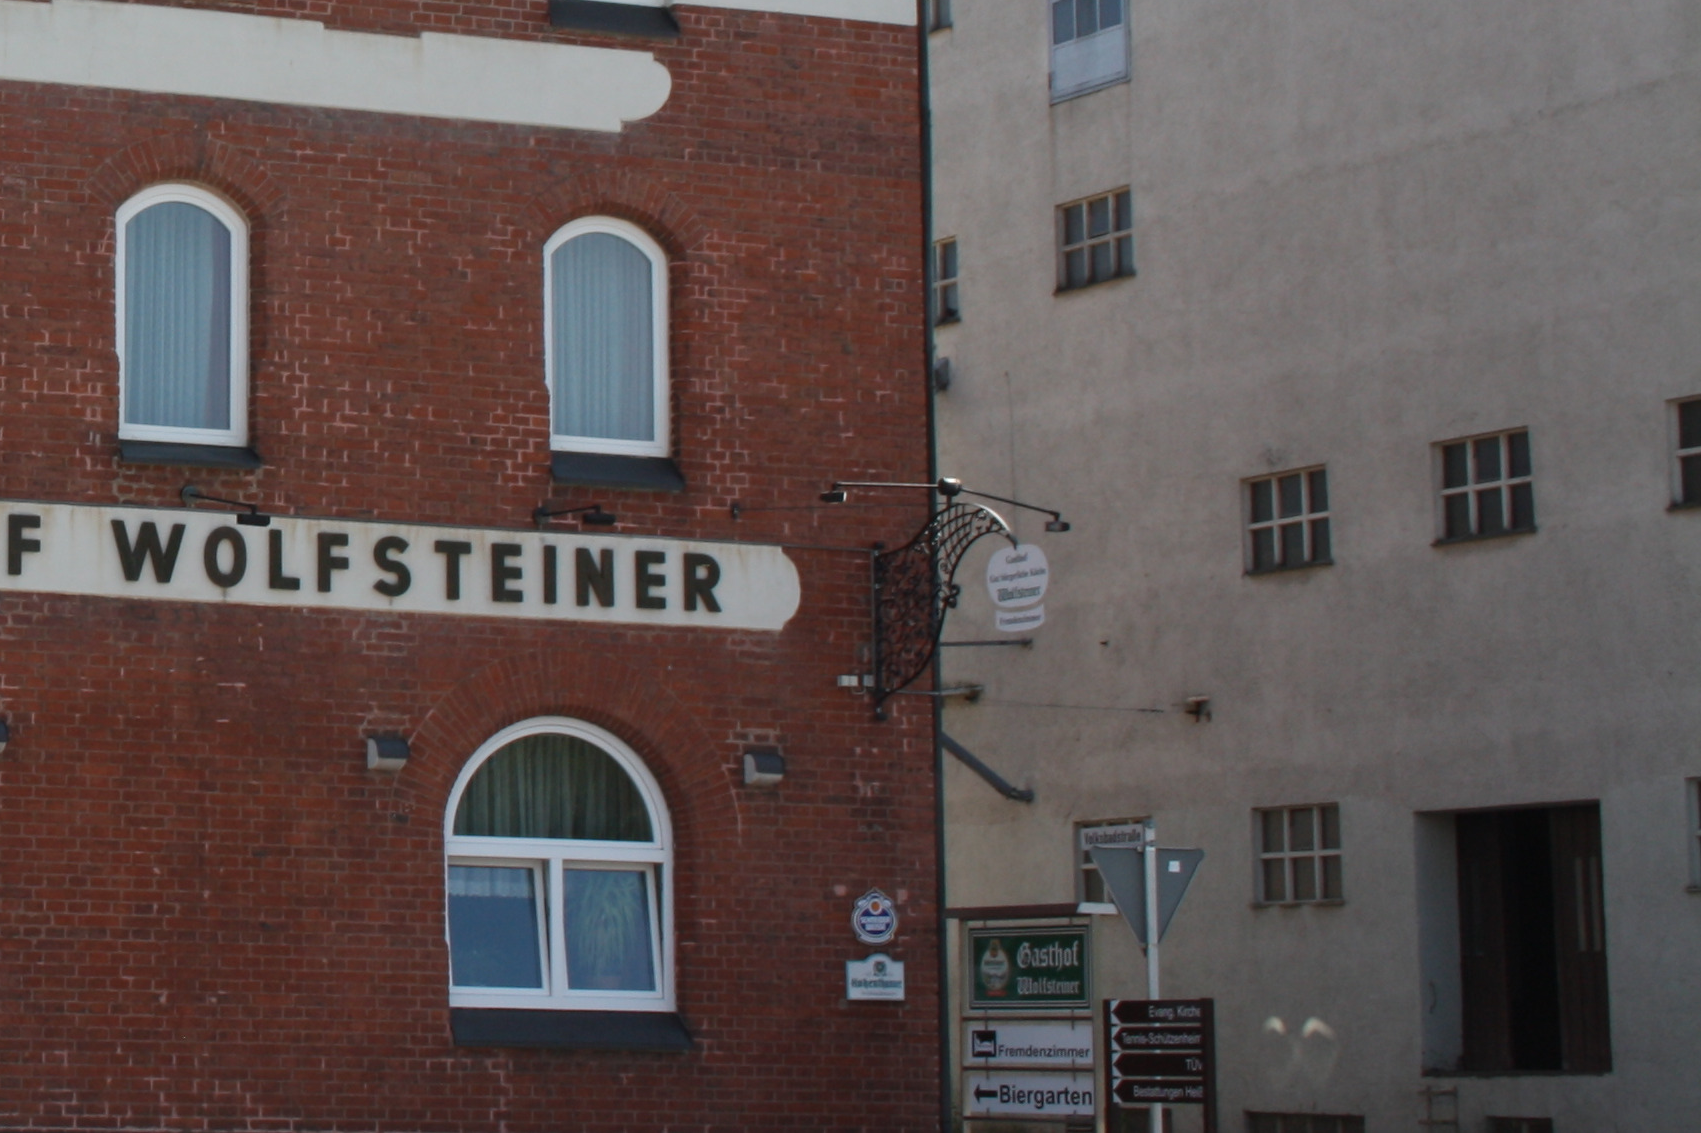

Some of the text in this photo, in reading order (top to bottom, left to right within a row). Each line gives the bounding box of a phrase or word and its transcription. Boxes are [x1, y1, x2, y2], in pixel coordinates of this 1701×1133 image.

[110, 519, 723, 613] WOLFSTEINER
[1016, 940, 1079, 971] Gasthof
[1016, 976, 1079, 995] Wolfsteiner
[998, 1045, 1090, 1058] Fremdenzimmer
[999, 1085, 1093, 1110] Biergarten
